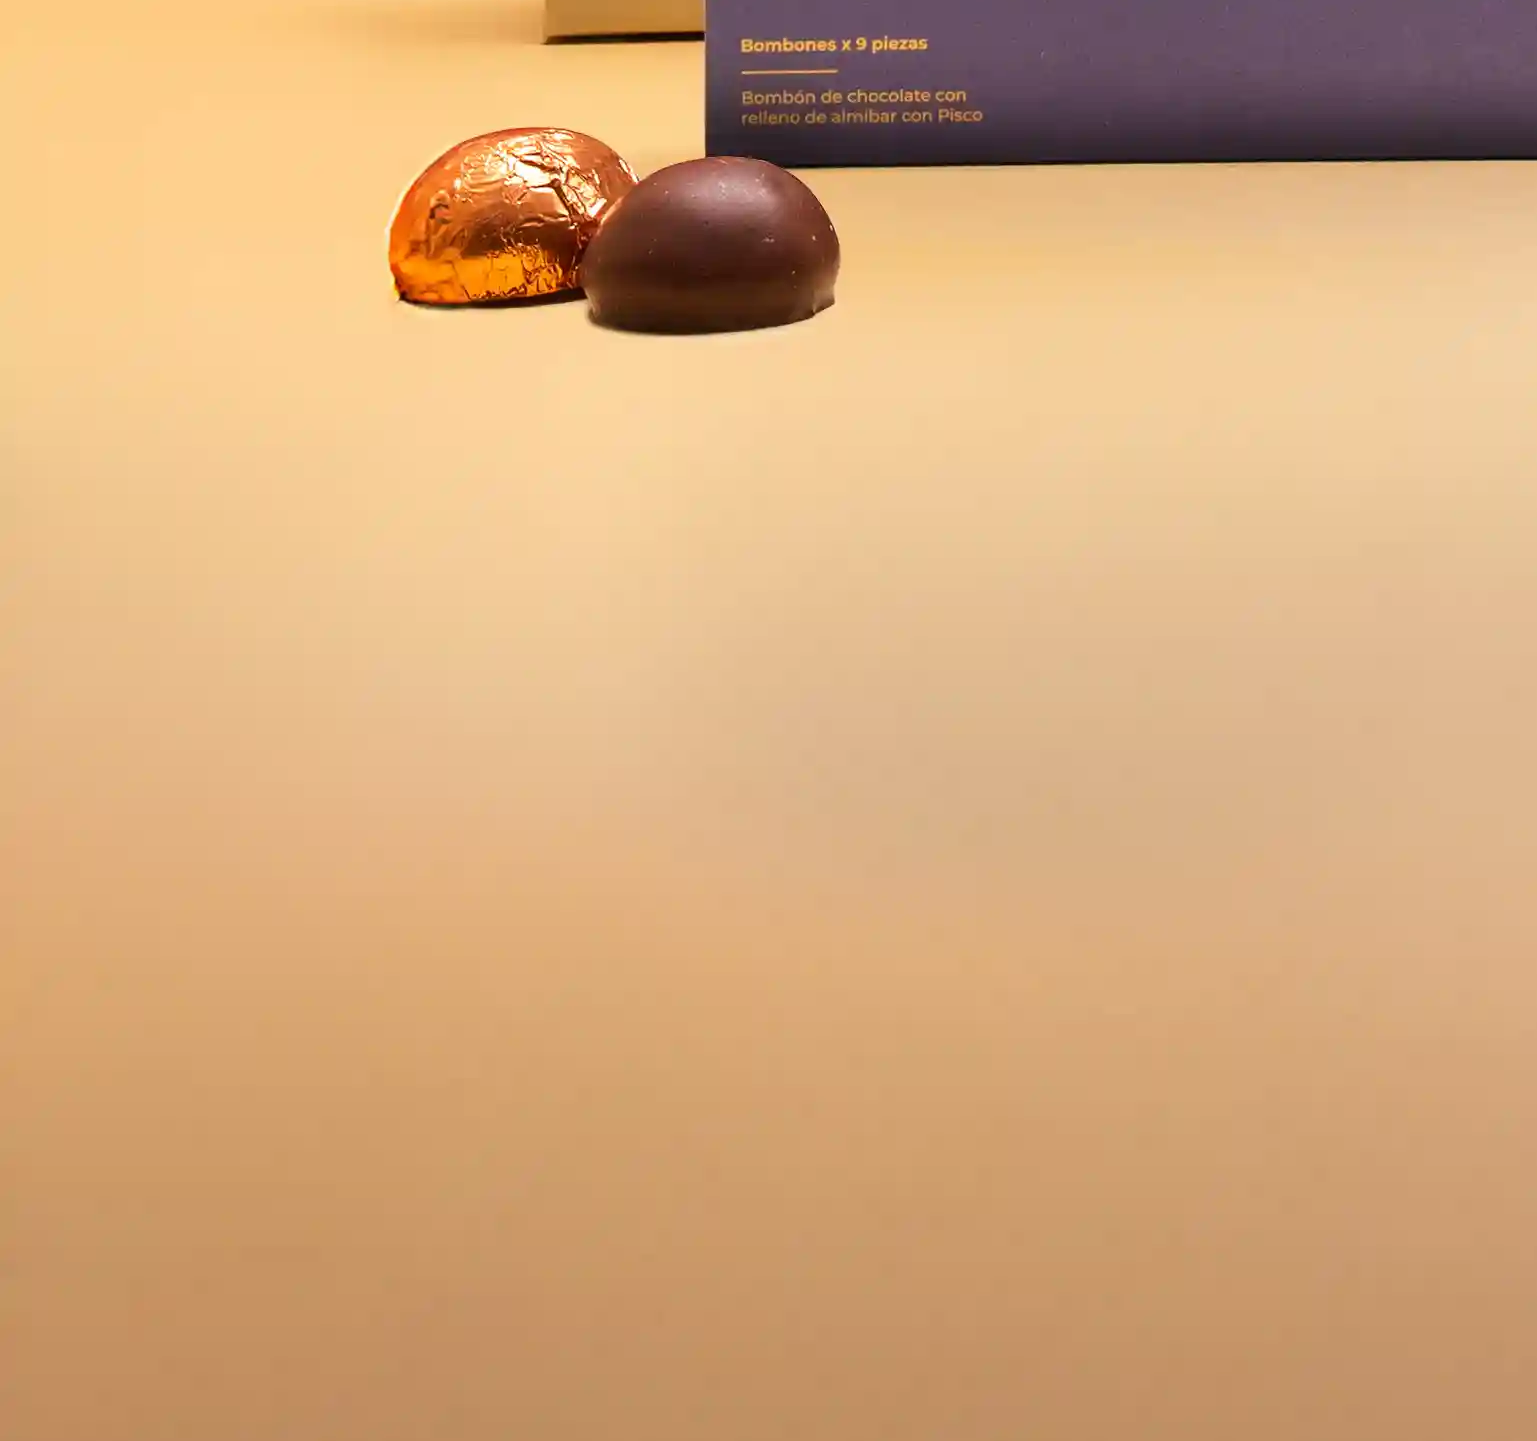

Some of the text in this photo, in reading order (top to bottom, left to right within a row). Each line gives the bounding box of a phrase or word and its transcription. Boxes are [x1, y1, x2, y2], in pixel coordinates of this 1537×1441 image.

[741, 36, 928, 54] Bombones x 9 piezas
[741, 89, 966, 105] Bombón de chocolate con
[741, 109, 801, 125] relleno
[805, 109, 827, 124] de
[902, 110, 932, 123] con
[938, 107, 983, 122] Pisco
